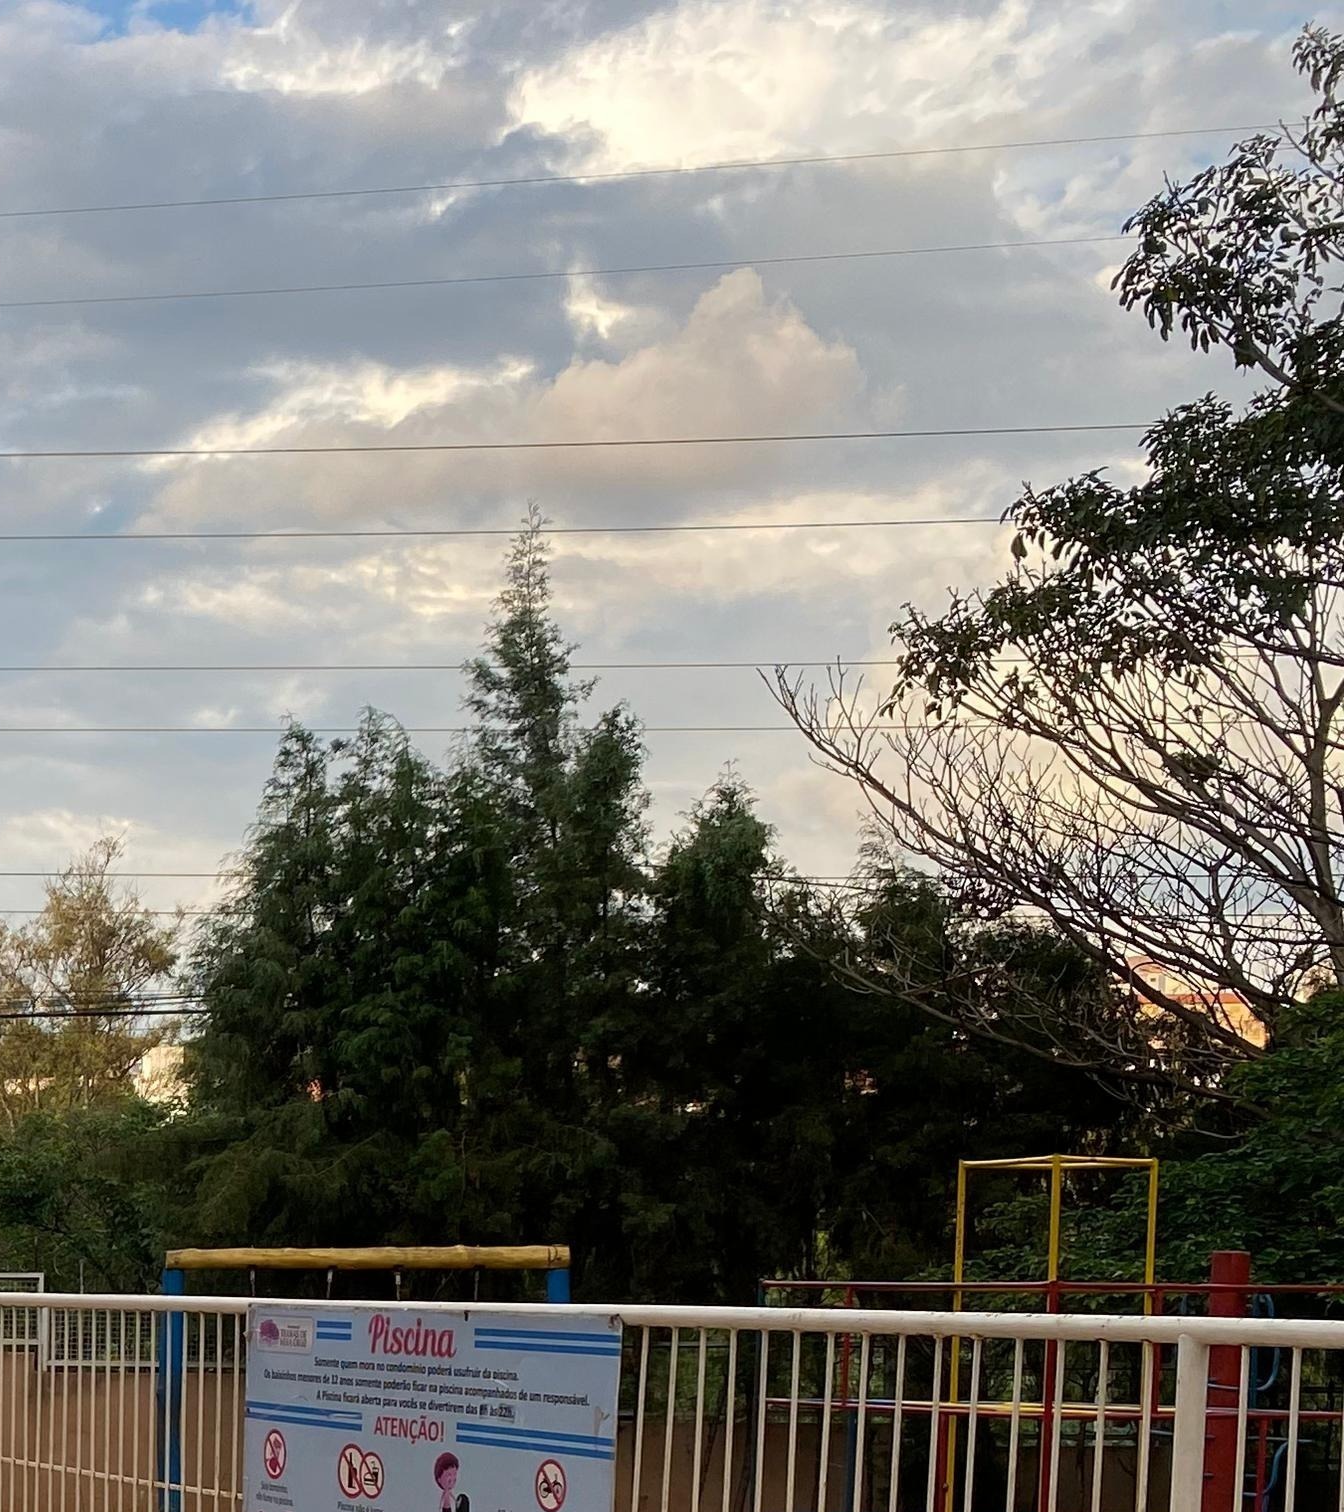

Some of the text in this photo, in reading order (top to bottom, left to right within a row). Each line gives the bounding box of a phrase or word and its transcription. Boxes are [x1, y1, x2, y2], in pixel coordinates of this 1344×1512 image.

[368, 1314, 457, 1358] Piscina
[341, 1361, 358, 1369] quem
[359, 1362, 375, 1370] mora
[377, 1363, 385, 1371] no
[340, 1378, 353, 1386] anos
[413, 1380, 427, 1391] ficar
[440, 1385, 463, 1395] piscina
[519, 1389, 528, 1401] de
[530, 1393, 541, 1401] um
[383, 1399, 397, 1407] para
[466, 1405, 477, 1414] das
[374, 1415, 444, 1444] ATENÇÃO!
